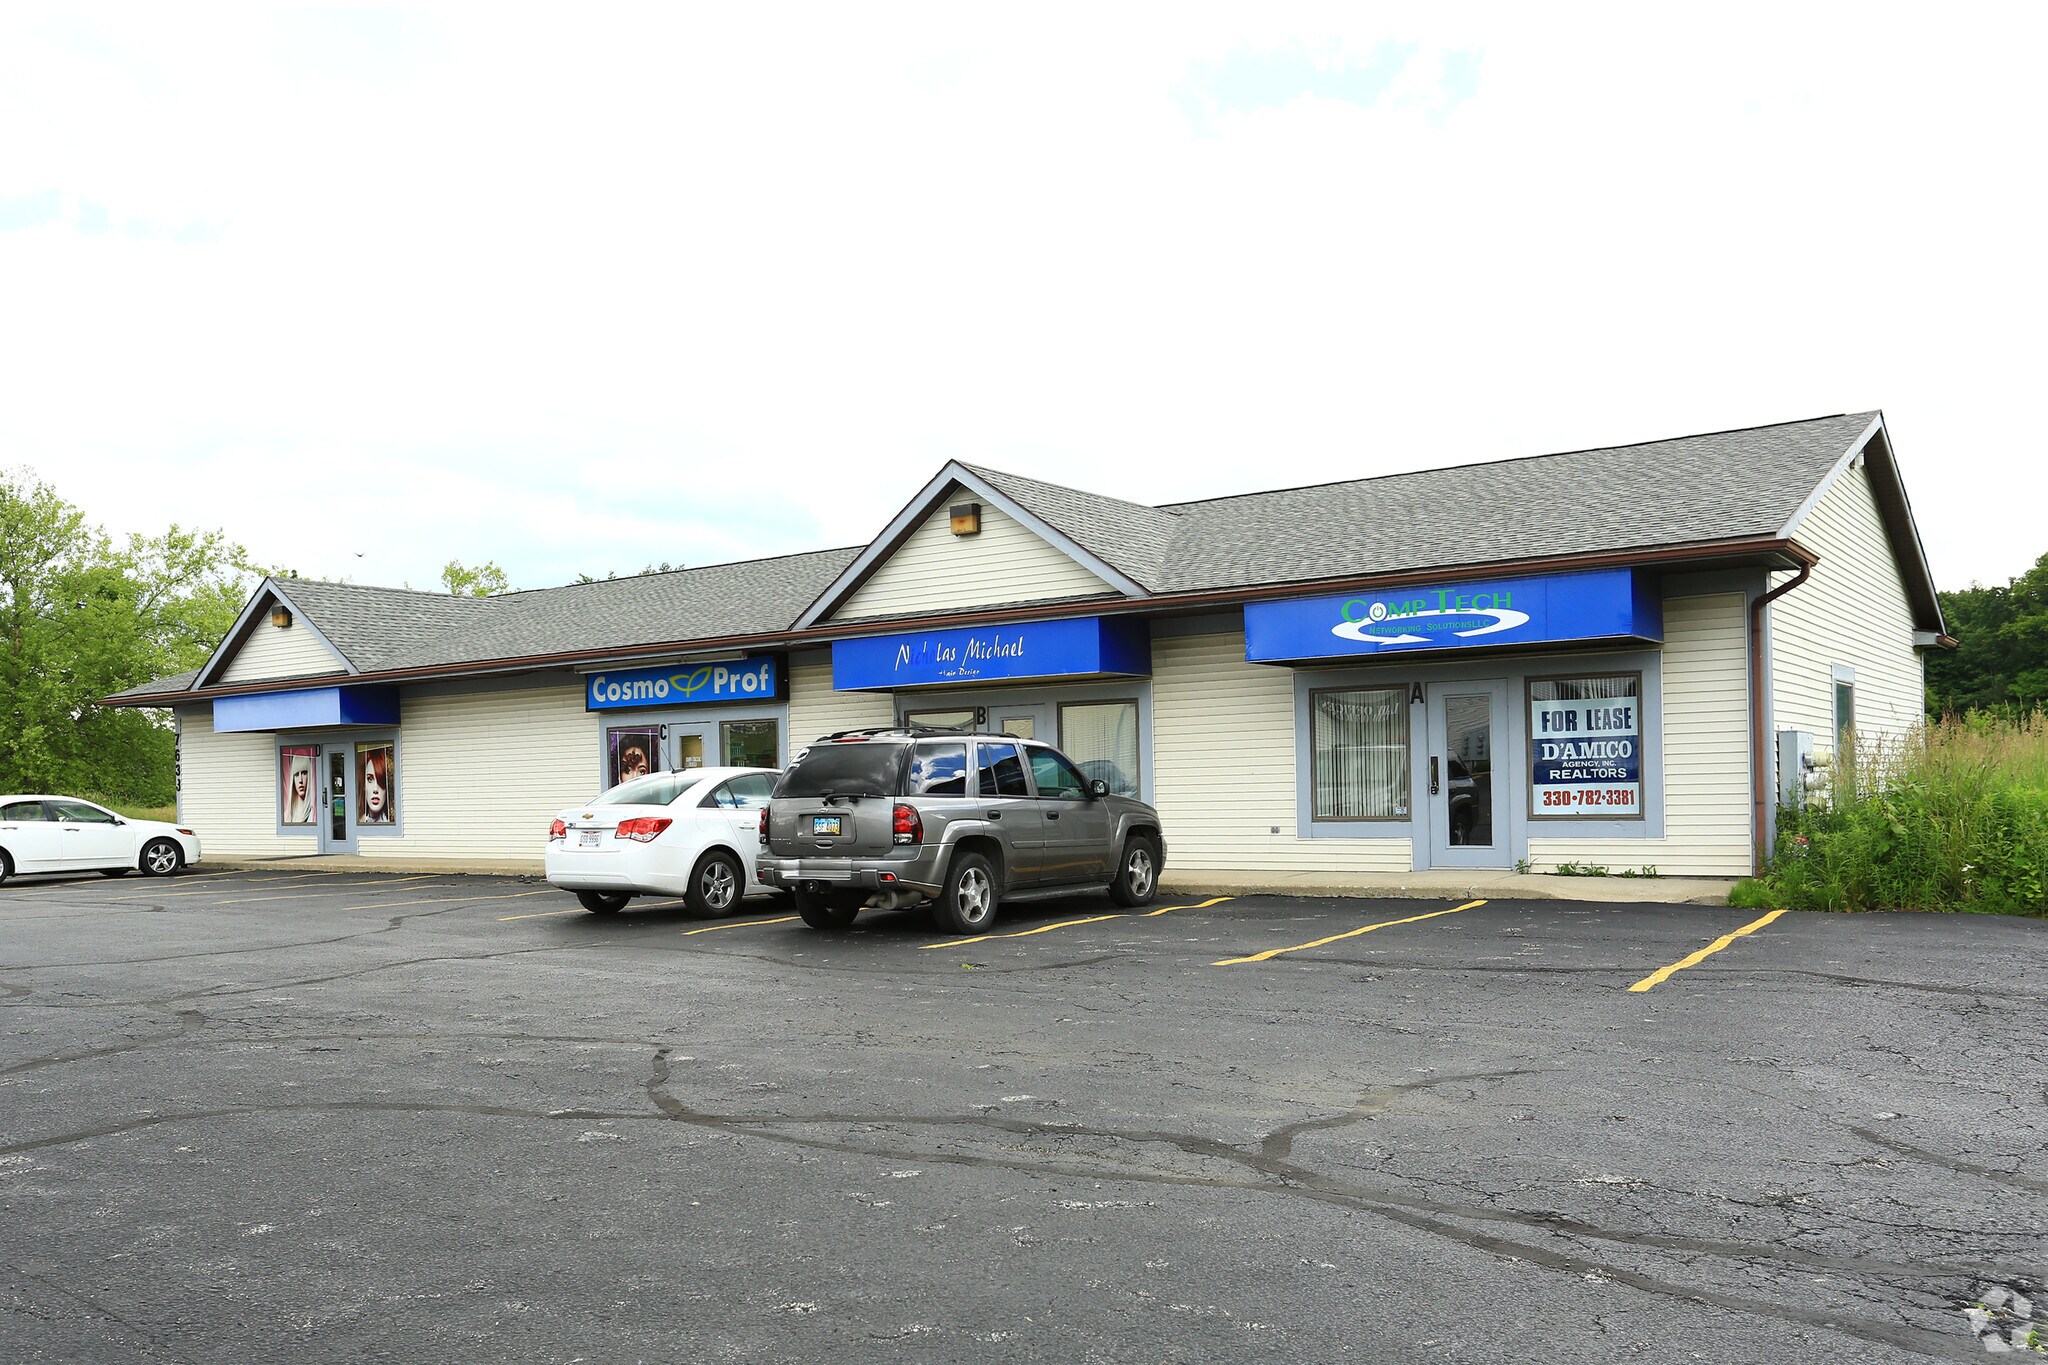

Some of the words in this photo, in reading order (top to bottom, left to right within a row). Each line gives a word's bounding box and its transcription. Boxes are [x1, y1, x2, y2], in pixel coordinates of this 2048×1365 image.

[1430, 589, 1512, 613] TECH
[962, 634, 1024, 667] Michael
[592, 676, 670, 702] Cosmo
[713, 663, 769, 694] Prof
[1410, 682, 1424, 704] A
[977, 706, 987, 725] B
[1541, 709, 1578, 732] FOR
[1586, 707, 1632, 731] LEASE
[660, 723, 667, 740] C
[1541, 740, 1633, 761] D'AMICO
[1549, 767, 1627, 780] REALTORS
